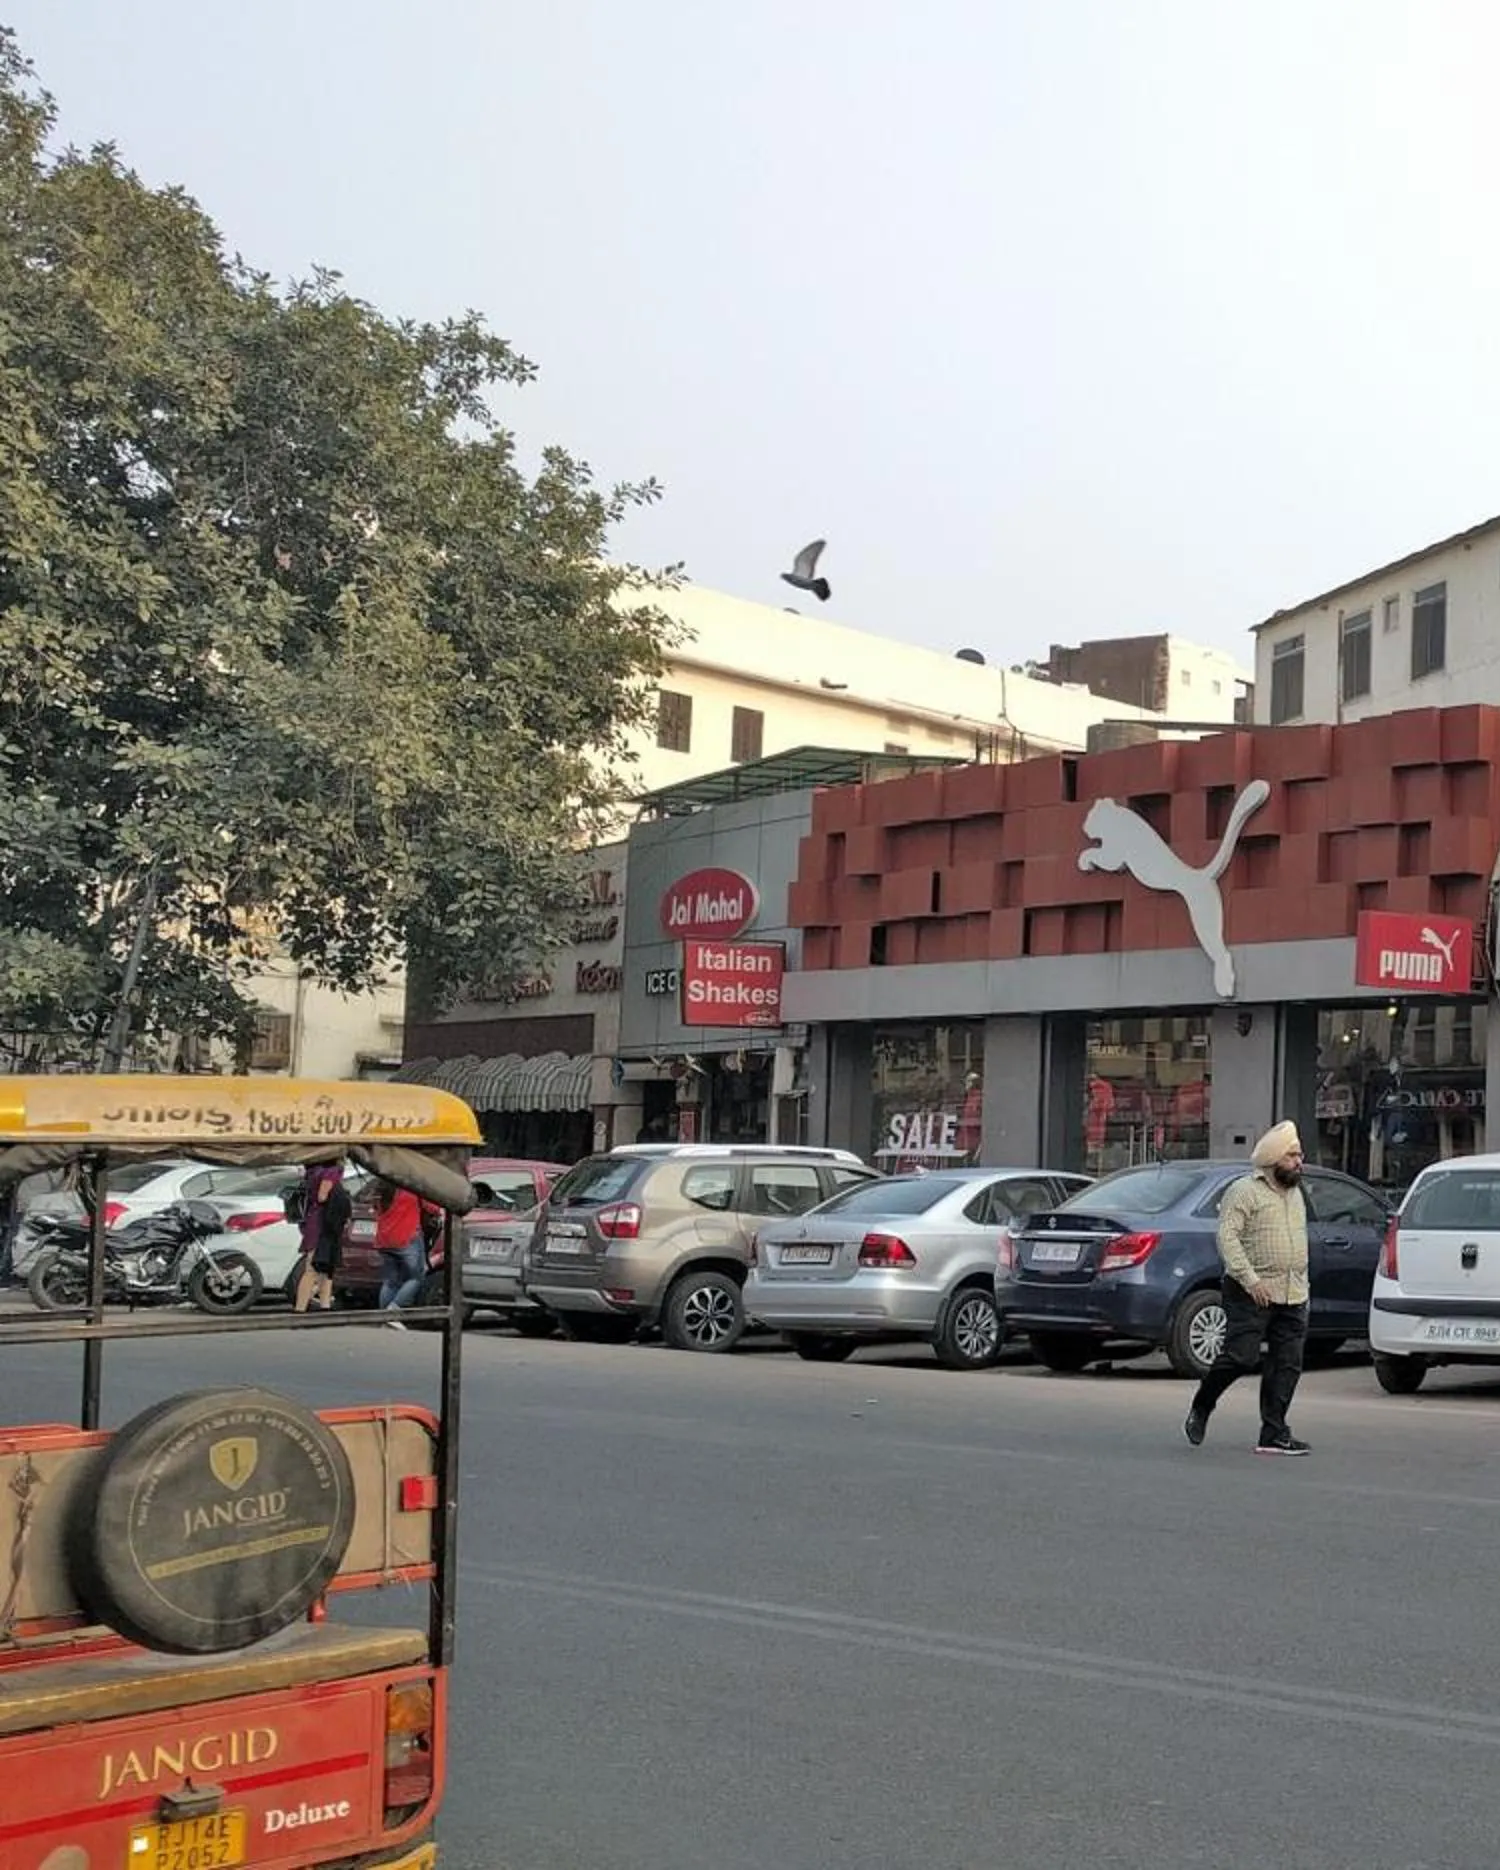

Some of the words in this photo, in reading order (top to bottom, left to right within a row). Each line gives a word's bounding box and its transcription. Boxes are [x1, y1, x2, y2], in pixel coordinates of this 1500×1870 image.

[669, 896, 690, 925] Jal
[695, 888, 743, 923] Mahal
[697, 947, 772, 971] Italian
[1380, 950, 1442, 982] PUMA
[647, 972, 666, 993] ICE
[688, 979, 778, 1005] Shakes
[888, 1113, 957, 1150] SALE
[183, 1491, 287, 1537] JANGID
[97, 1727, 278, 1799] JANGID
[264, 1800, 350, 1834] Deluxe
